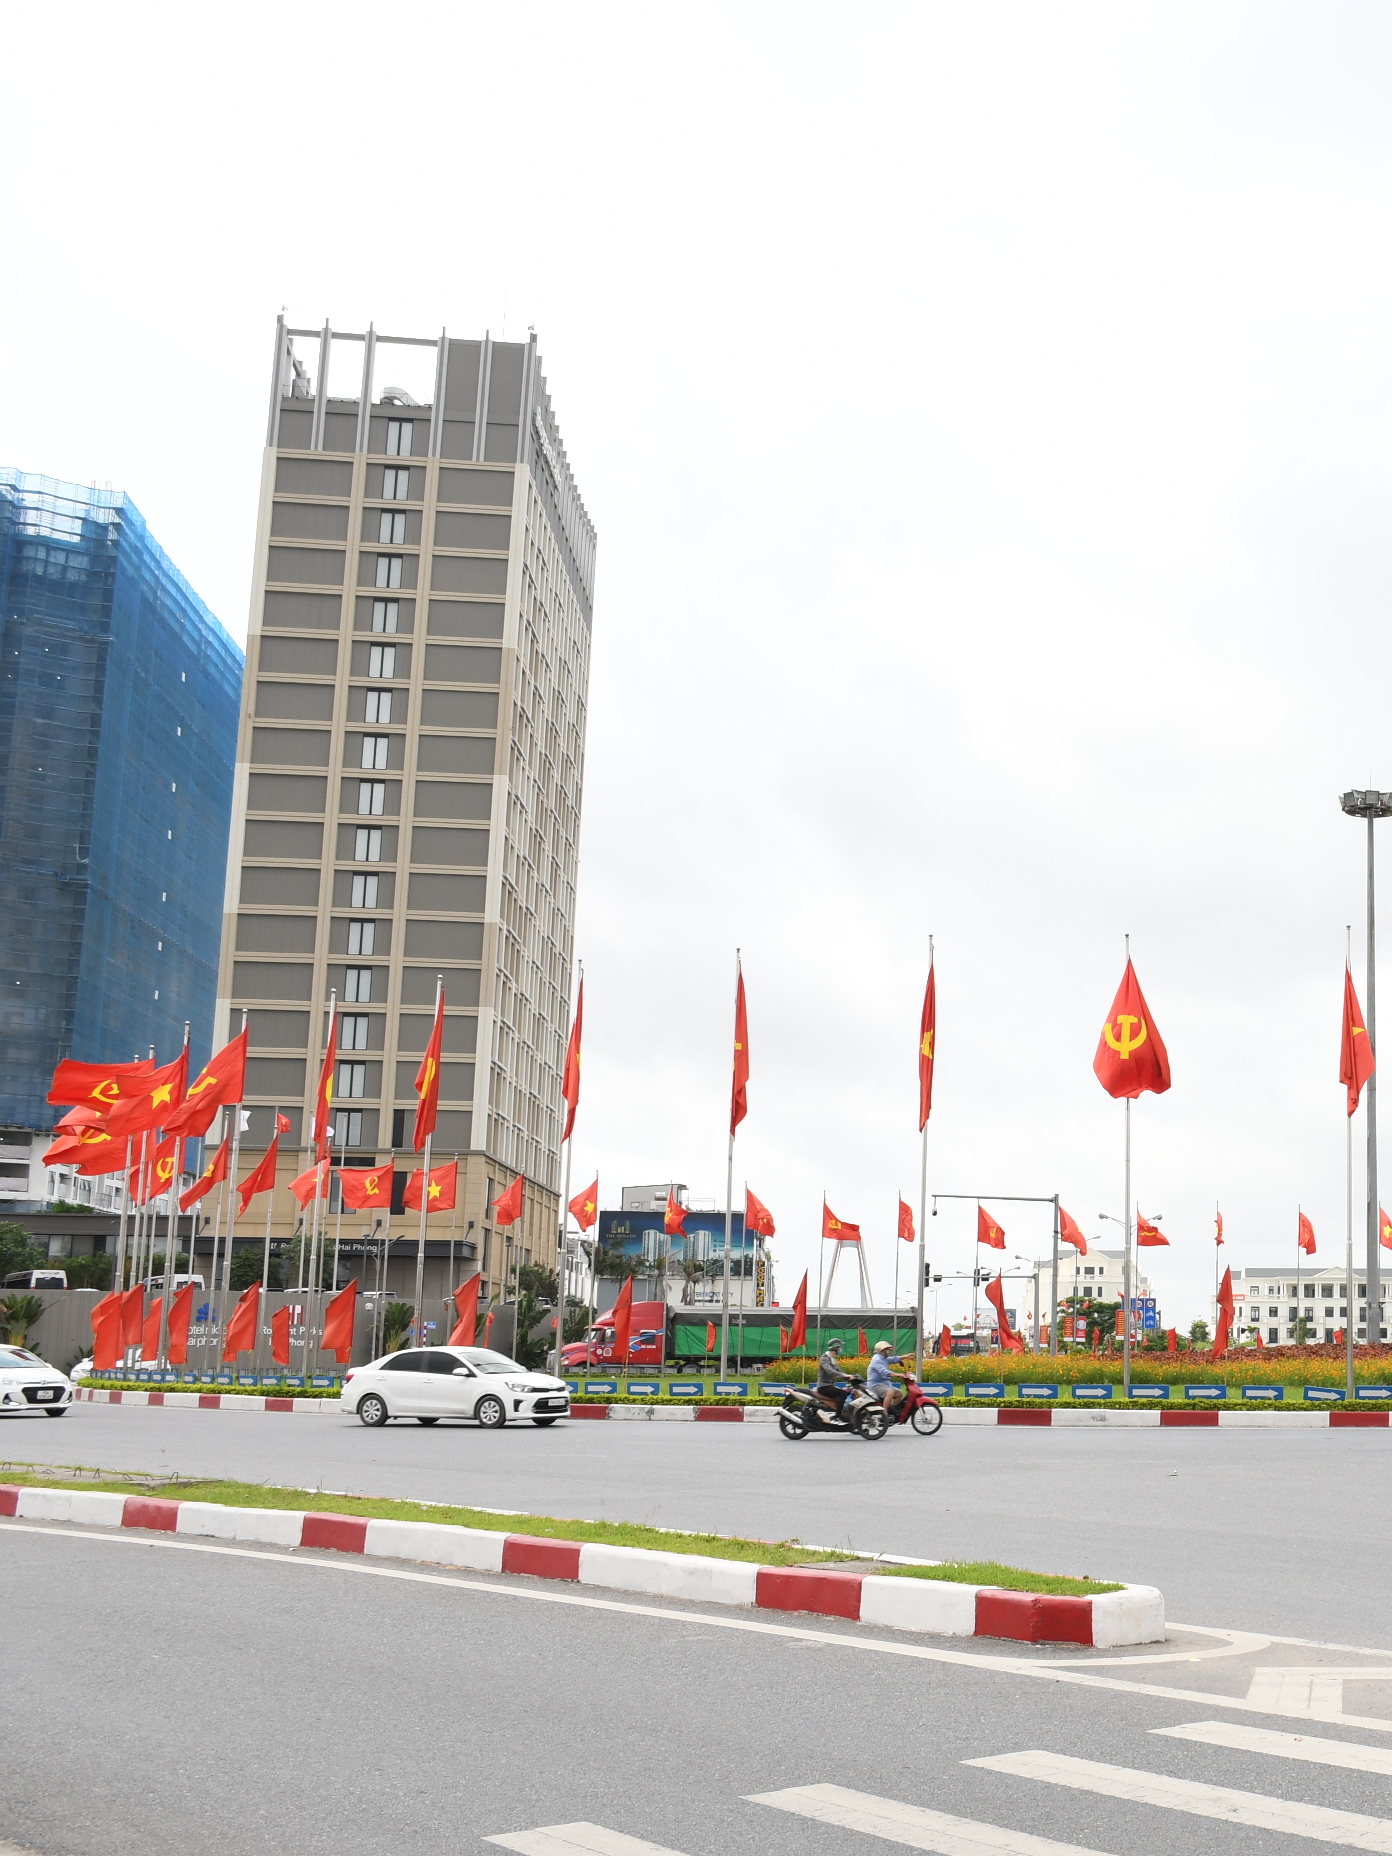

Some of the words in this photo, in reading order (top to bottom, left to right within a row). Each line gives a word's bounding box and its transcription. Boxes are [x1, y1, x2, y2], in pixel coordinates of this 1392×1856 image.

[338, 1243, 351, 1251] Hai
[757, 1261, 765, 1287] FOOT
[187, 1324, 205, 1335] otel
